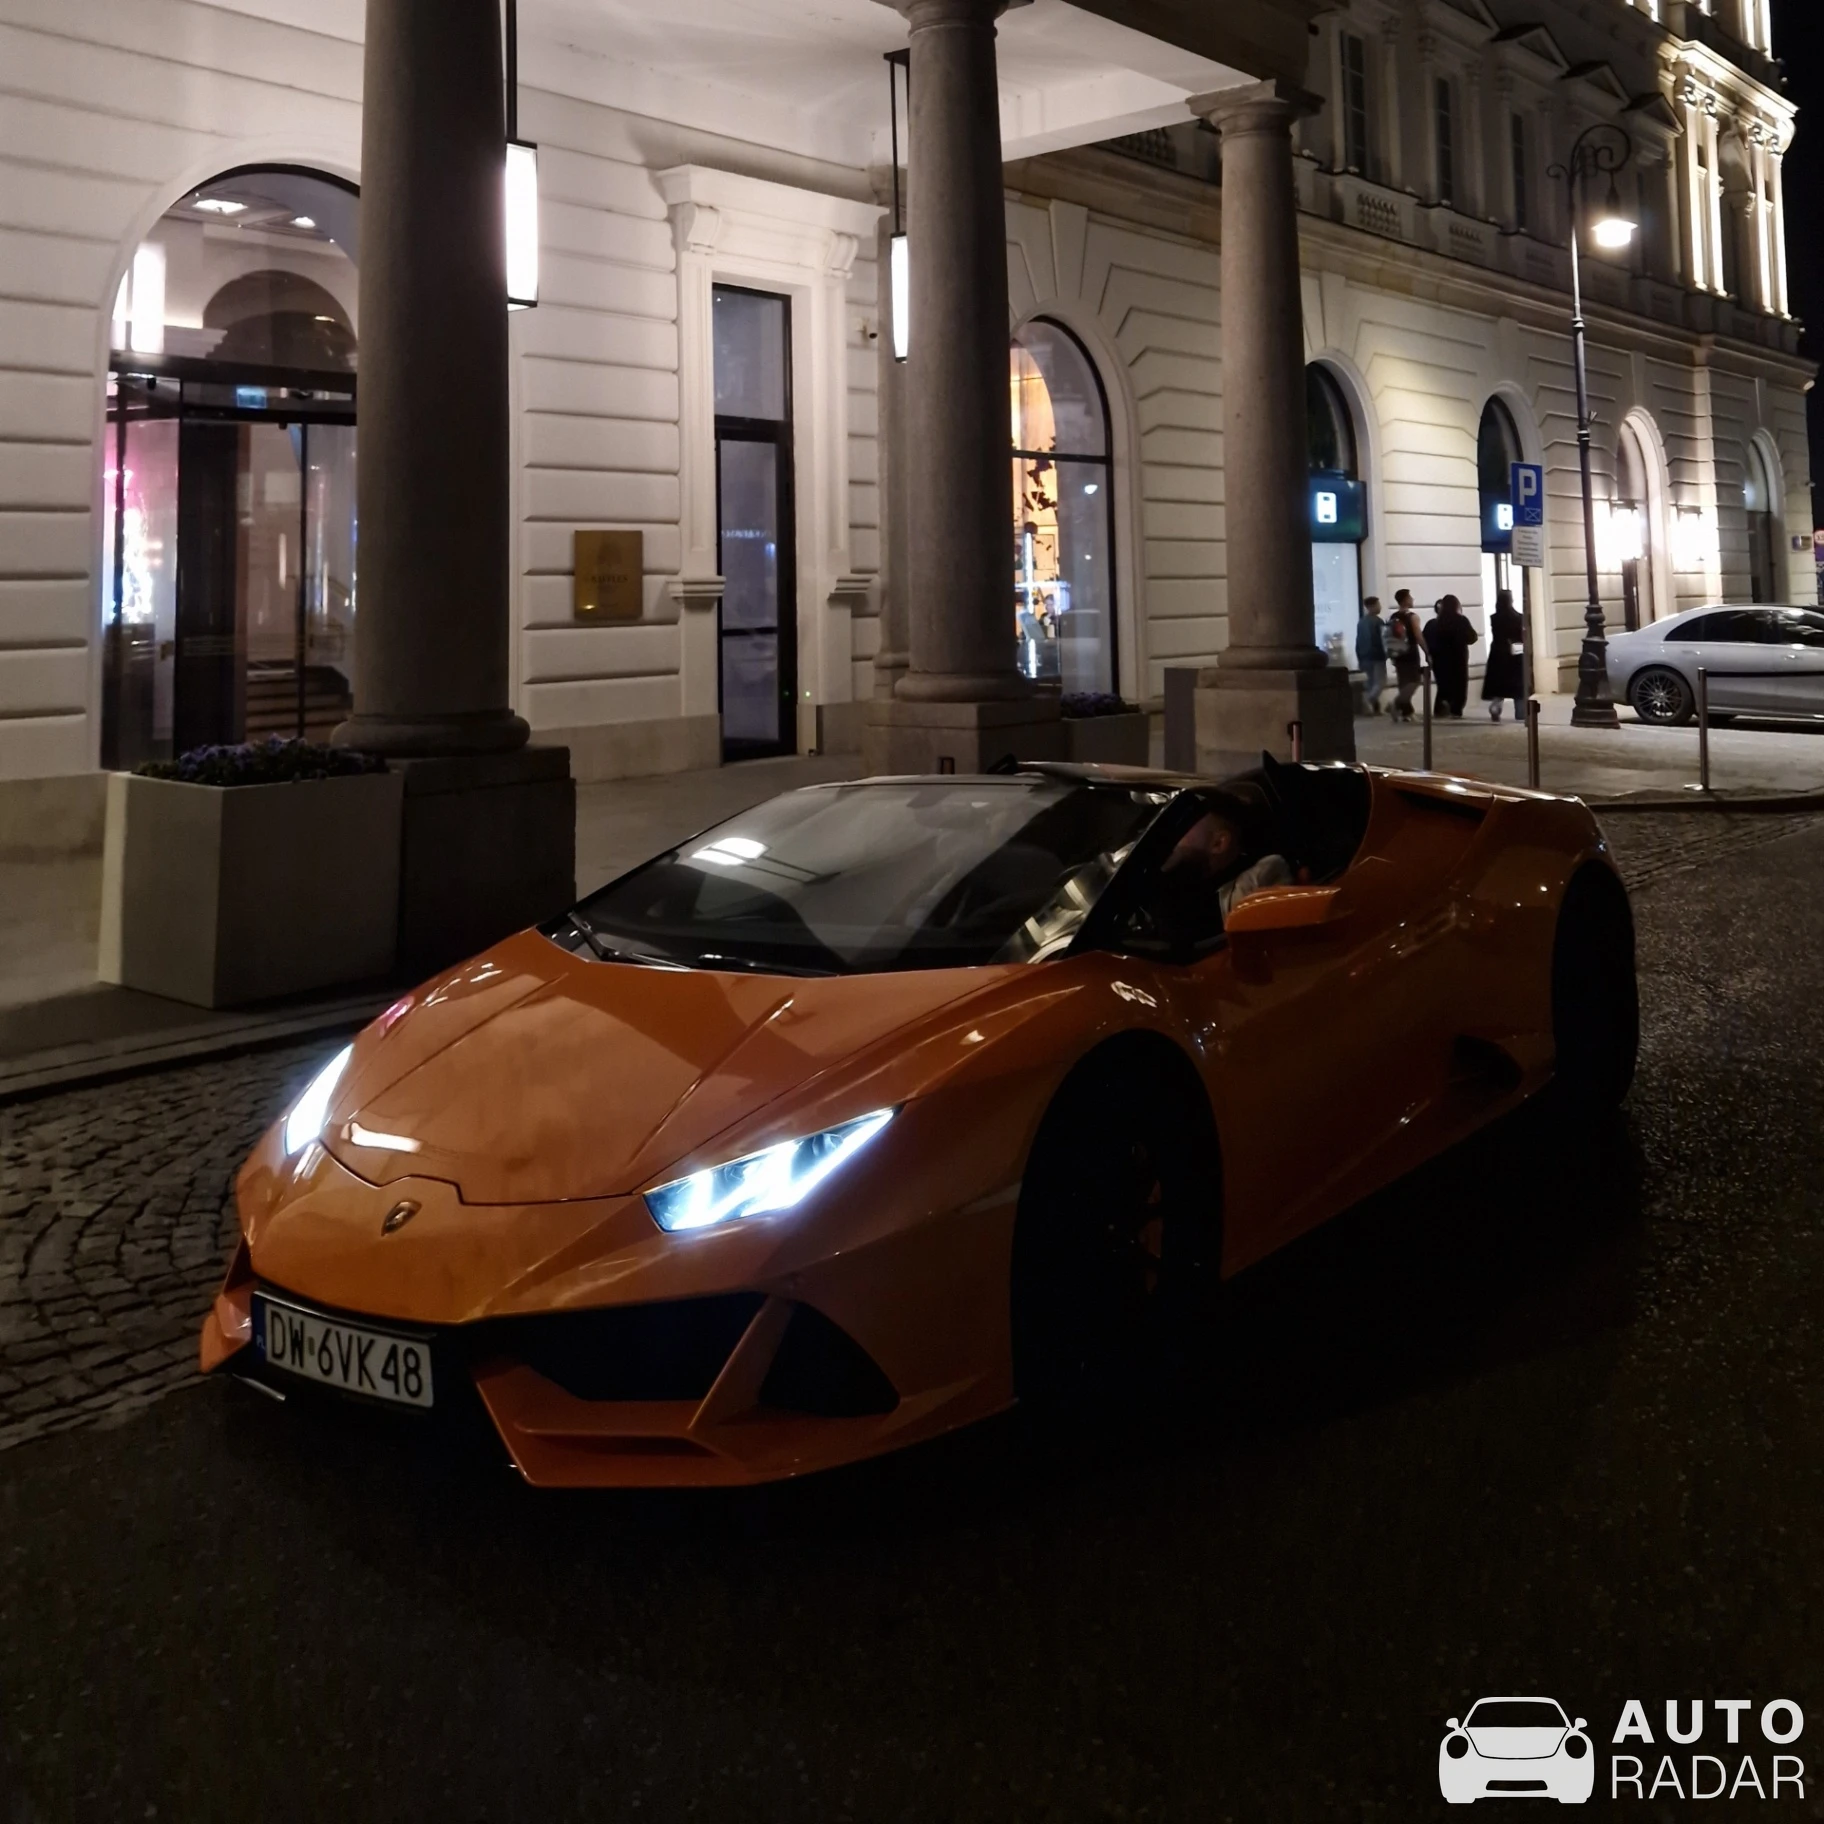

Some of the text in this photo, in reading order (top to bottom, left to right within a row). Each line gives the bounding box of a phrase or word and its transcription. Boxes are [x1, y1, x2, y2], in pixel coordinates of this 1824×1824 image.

[1518, 468, 1537, 506] P
[271, 1310, 423, 1398] DW 6VK48
